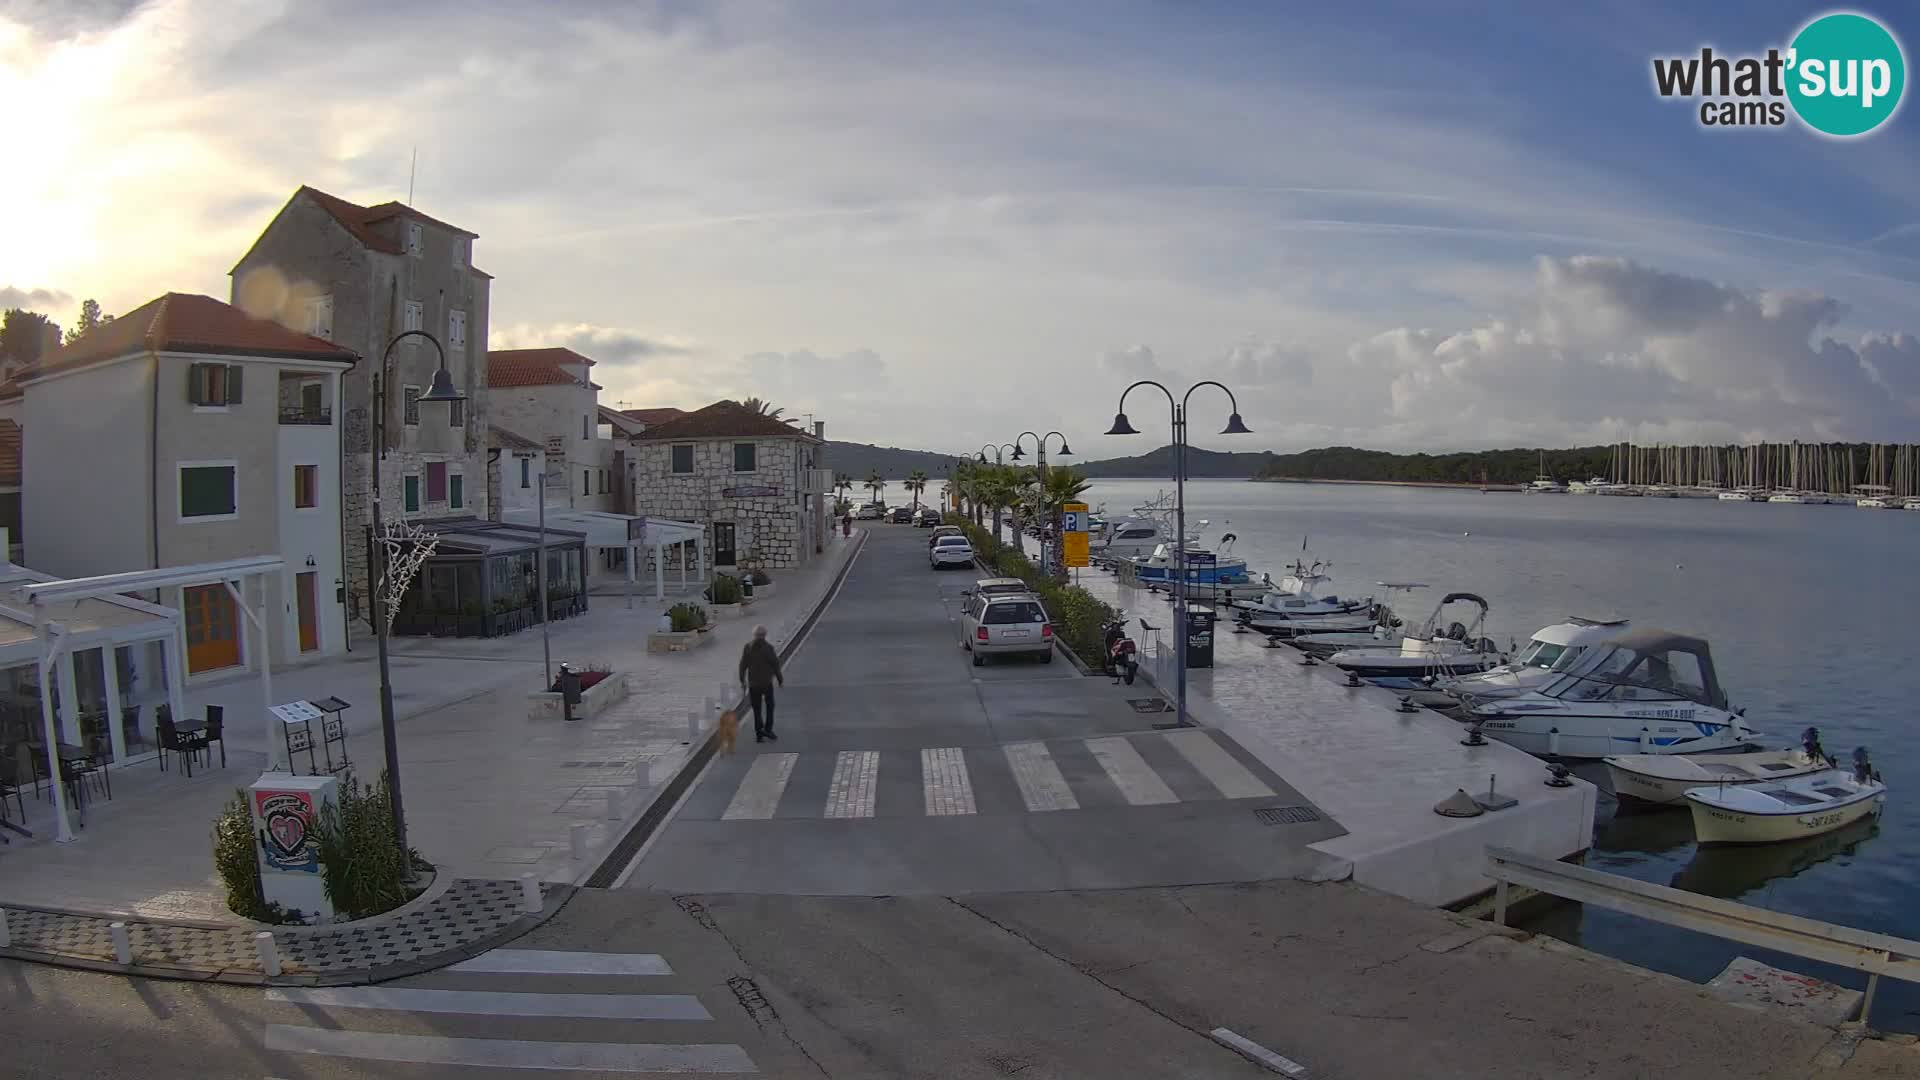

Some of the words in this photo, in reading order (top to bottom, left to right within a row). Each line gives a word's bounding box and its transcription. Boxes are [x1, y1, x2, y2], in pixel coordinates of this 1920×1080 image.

[1066, 513, 1076, 530] P
[1656, 709, 1673, 719] RENT
[1680, 709, 1696, 720] BOAT
